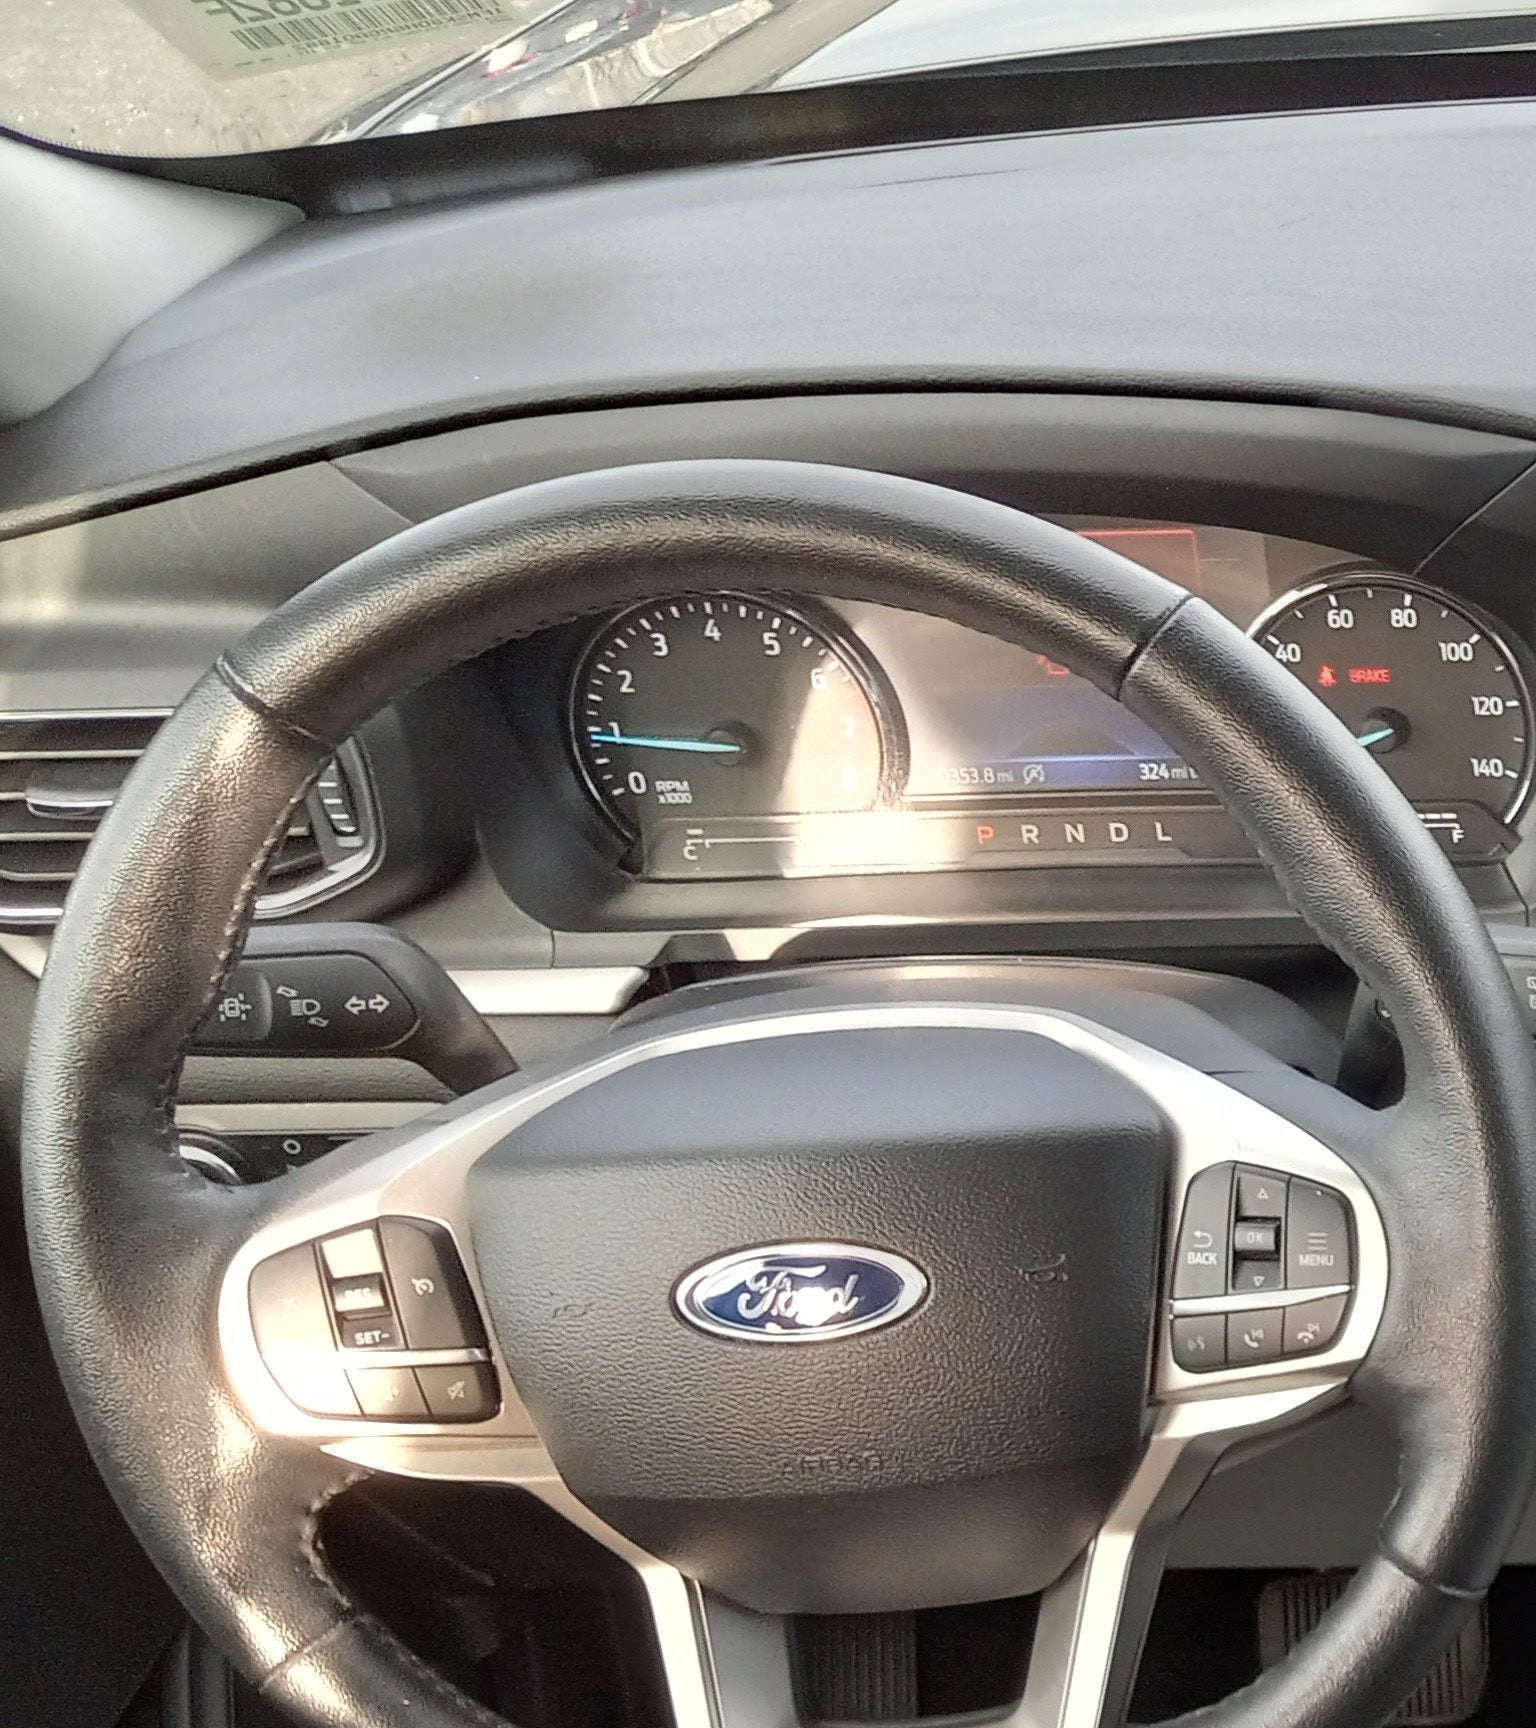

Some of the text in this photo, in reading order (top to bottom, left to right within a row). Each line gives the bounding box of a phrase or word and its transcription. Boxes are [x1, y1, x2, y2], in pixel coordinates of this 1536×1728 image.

[1327, 608, 1355, 629] 60
[1391, 607, 1418, 628] 80
[704, 618, 722, 642] 4
[651, 632, 669, 657] 3
[763, 631, 781, 656] 5
[1275, 643, 1302, 663] 40
[1438, 642, 1474, 662] 100
[617, 669, 636, 694] 2
[809, 667, 830, 691] 6
[1348, 667, 1390, 684] BRAKE
[1472, 696, 1504, 716] 120
[627, 761, 647, 794] 0
[997, 770, 1014, 783] mi
[1138, 763, 1169, 780] 324
[1470, 759, 1504, 779] 140
[655, 780, 690, 793] RPM
[658, 792, 693, 804] x1000
[977, 821, 1173, 844] P R N D L
[1452, 828, 1464, 844] F
[1246, 1232, 1264, 1244] OK
[1187, 1253, 1218, 1266] BACK
[1299, 1254, 1335, 1267] MENU
[736, 1263, 864, 1326] Ford
